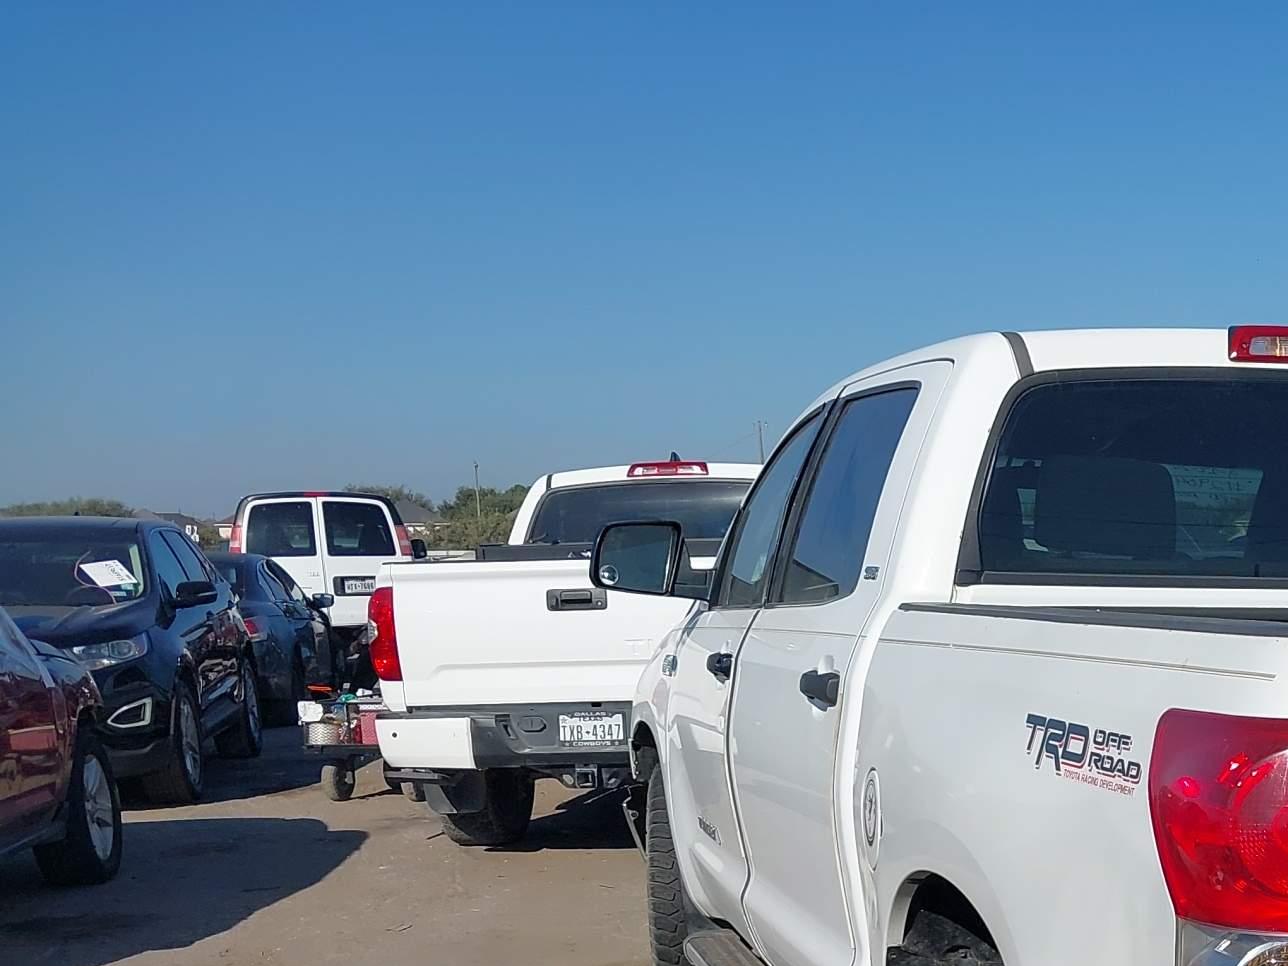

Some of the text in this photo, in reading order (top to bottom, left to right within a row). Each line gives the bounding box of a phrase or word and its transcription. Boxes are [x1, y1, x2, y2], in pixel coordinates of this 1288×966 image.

[1026, 713, 1090, 776] TRD
[1092, 728, 1132, 755] OFF
[1063, 768, 1135, 796] TOYOTA RACING DEVELOPMENT
[1087, 751, 1142, 784] ROAD
